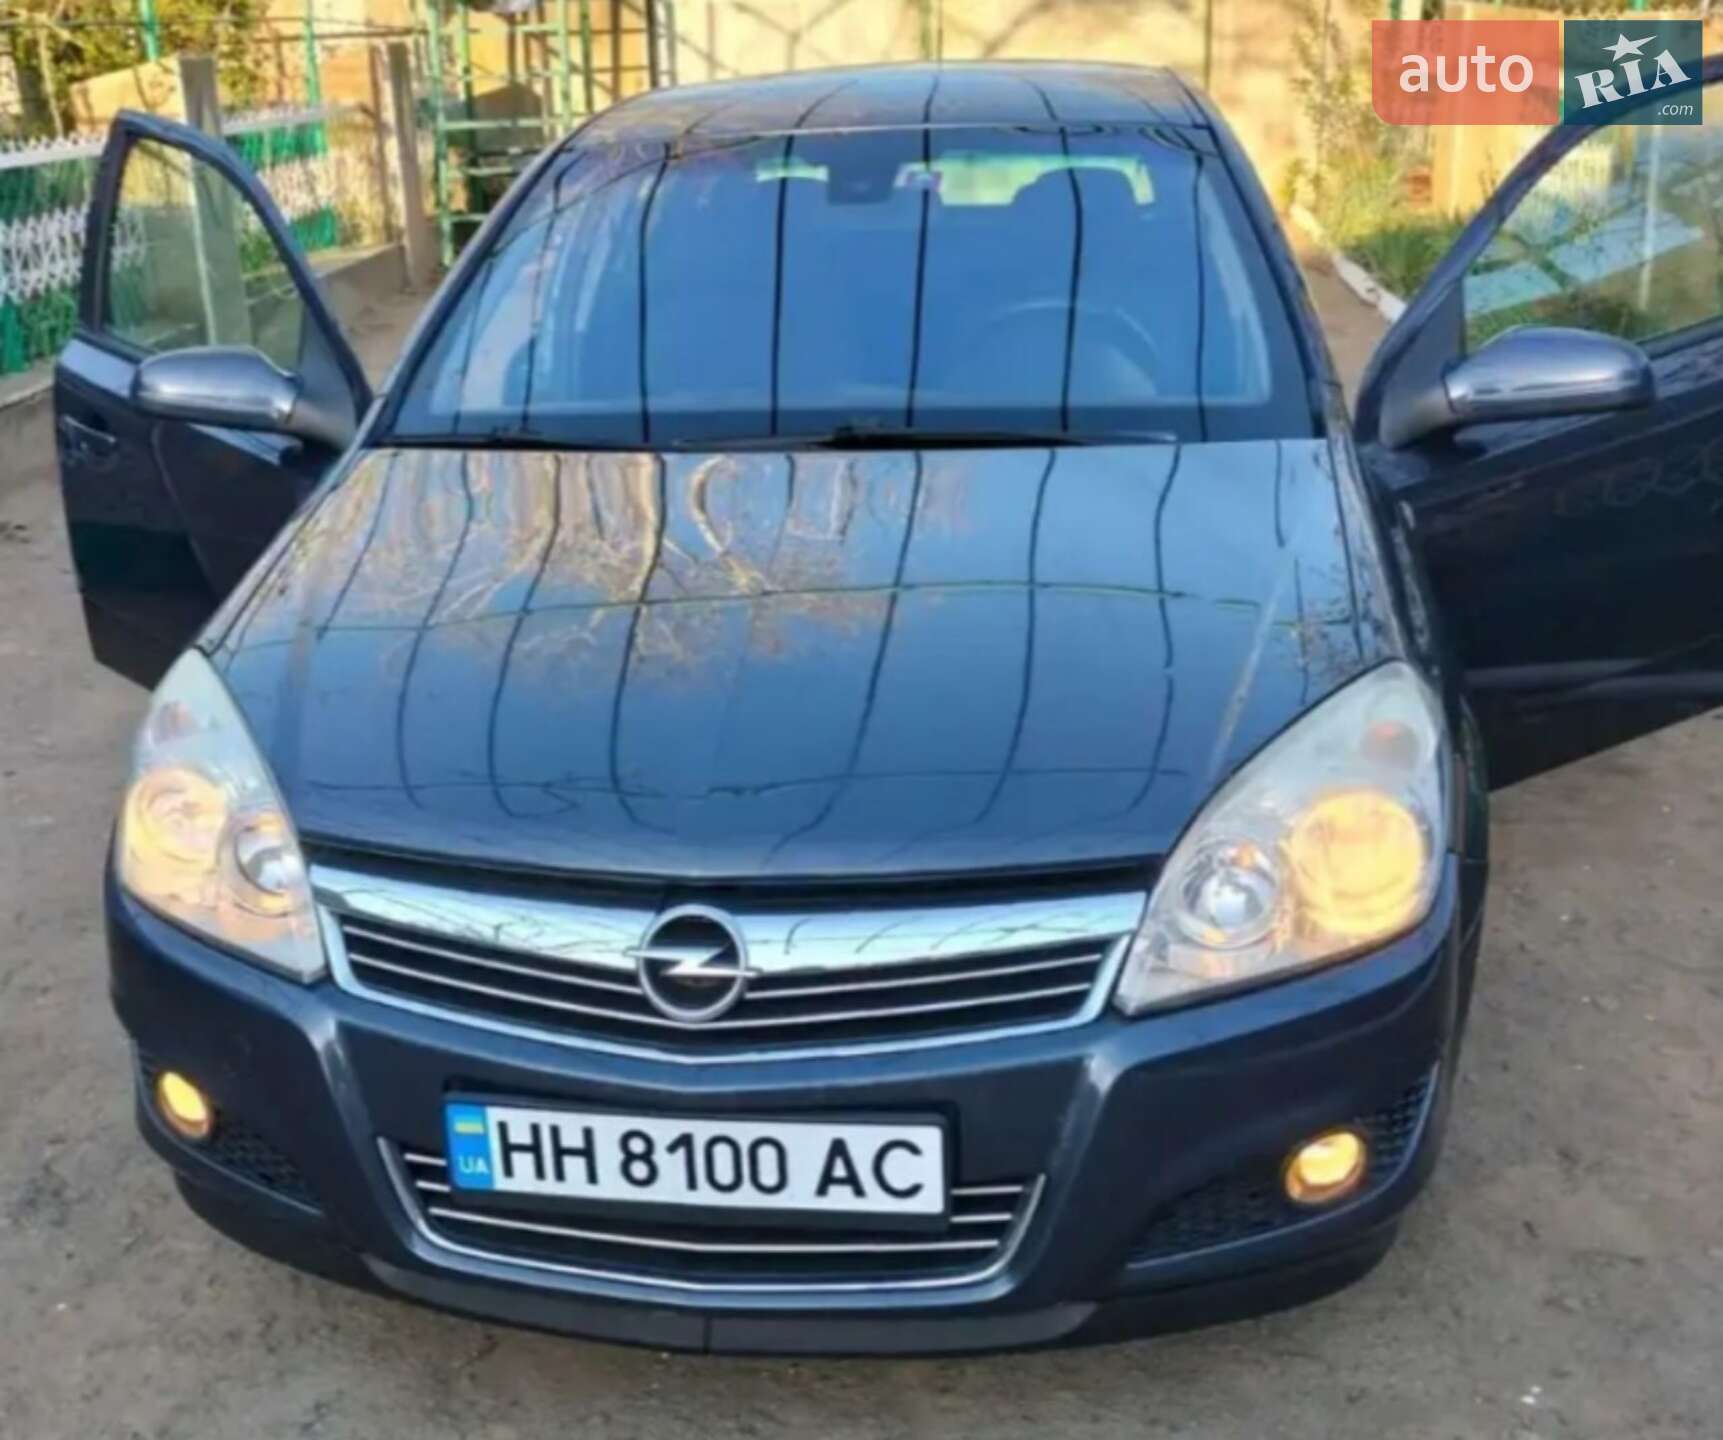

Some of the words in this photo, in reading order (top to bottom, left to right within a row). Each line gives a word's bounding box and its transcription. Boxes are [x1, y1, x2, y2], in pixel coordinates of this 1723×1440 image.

[458, 1154, 489, 1175] UA
[497, 1120, 599, 1185] HH
[618, 1129, 789, 1195] 8100
[815, 1137, 925, 1199] AC
